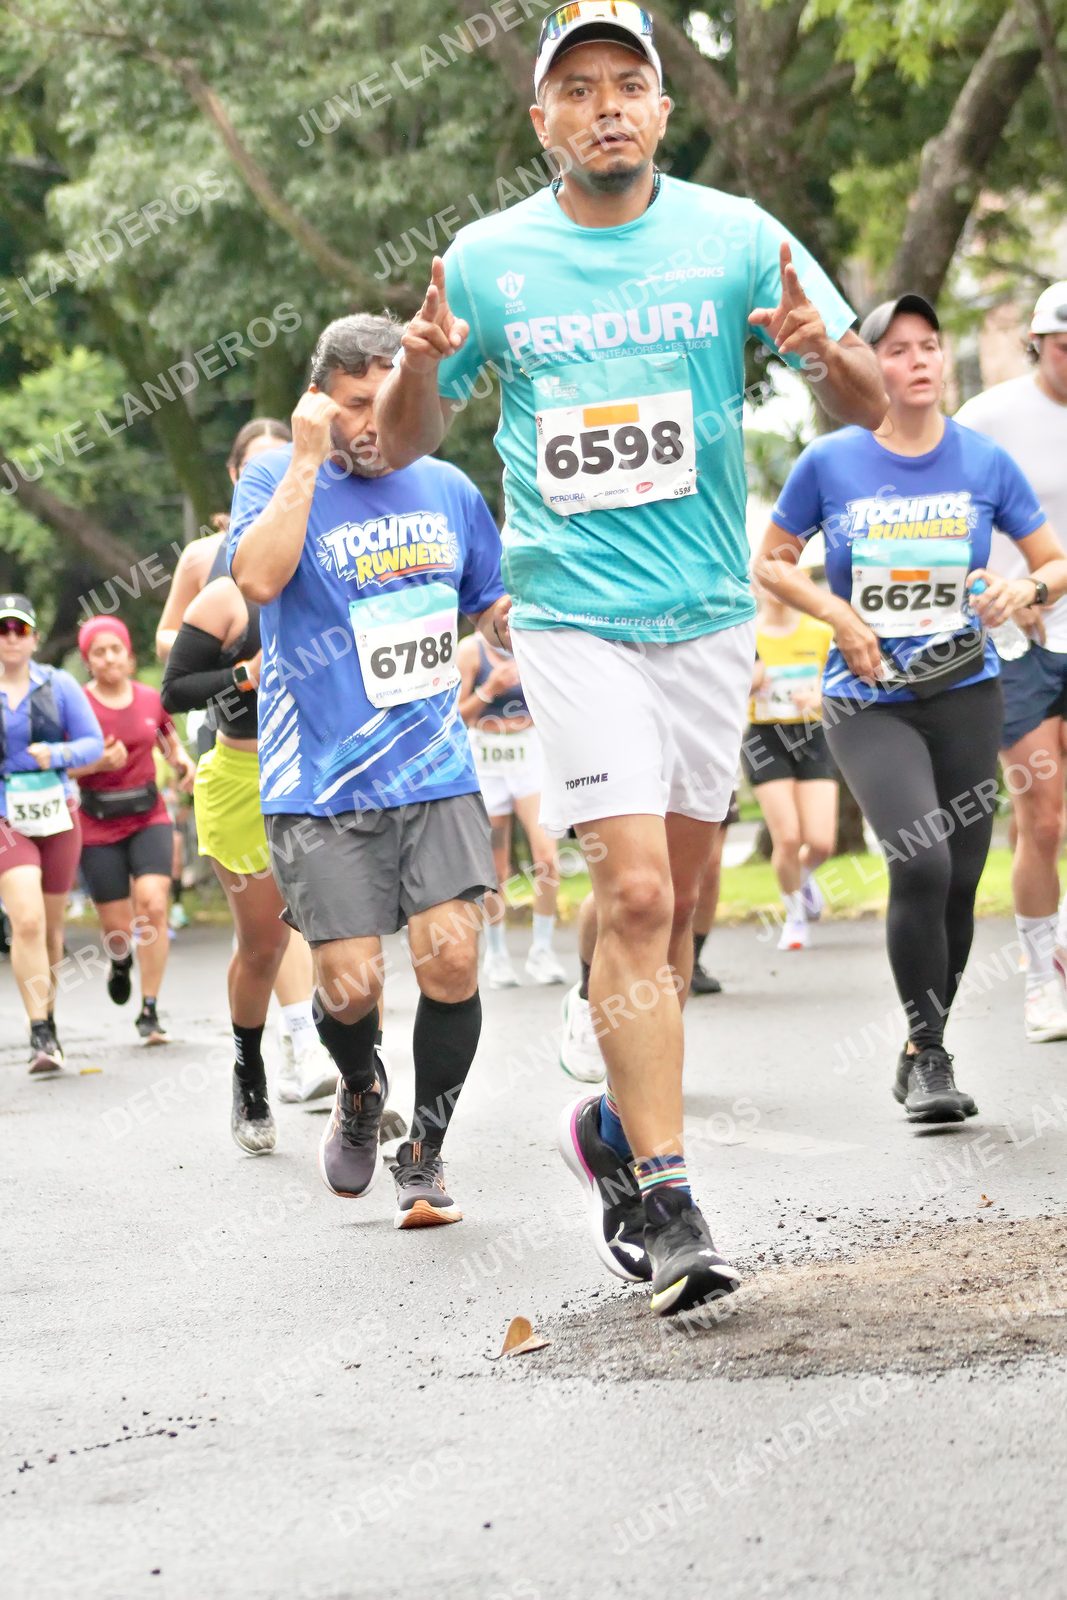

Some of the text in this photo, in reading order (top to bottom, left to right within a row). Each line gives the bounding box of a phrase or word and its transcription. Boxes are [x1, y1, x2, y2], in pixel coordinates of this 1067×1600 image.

[664, 266, 725, 282] BROOKS
[504, 299, 719, 361] PERDURA
[544, 420, 684, 480] 6598
[550, 492, 587, 503] PERDURA
[850, 492, 970, 532] TOCHITOS
[321, 513, 449, 571] TOCHITOS
[867, 517, 969, 540] RUNNERS
[355, 543, 453, 584] RUNNERS
[860, 583, 957, 612] 6625
[614, 615, 675, 628] corriendo
[370, 631, 453, 680] 6788
[565, 772, 609, 790] TOPTIME
[13, 798, 61, 821] 3567
